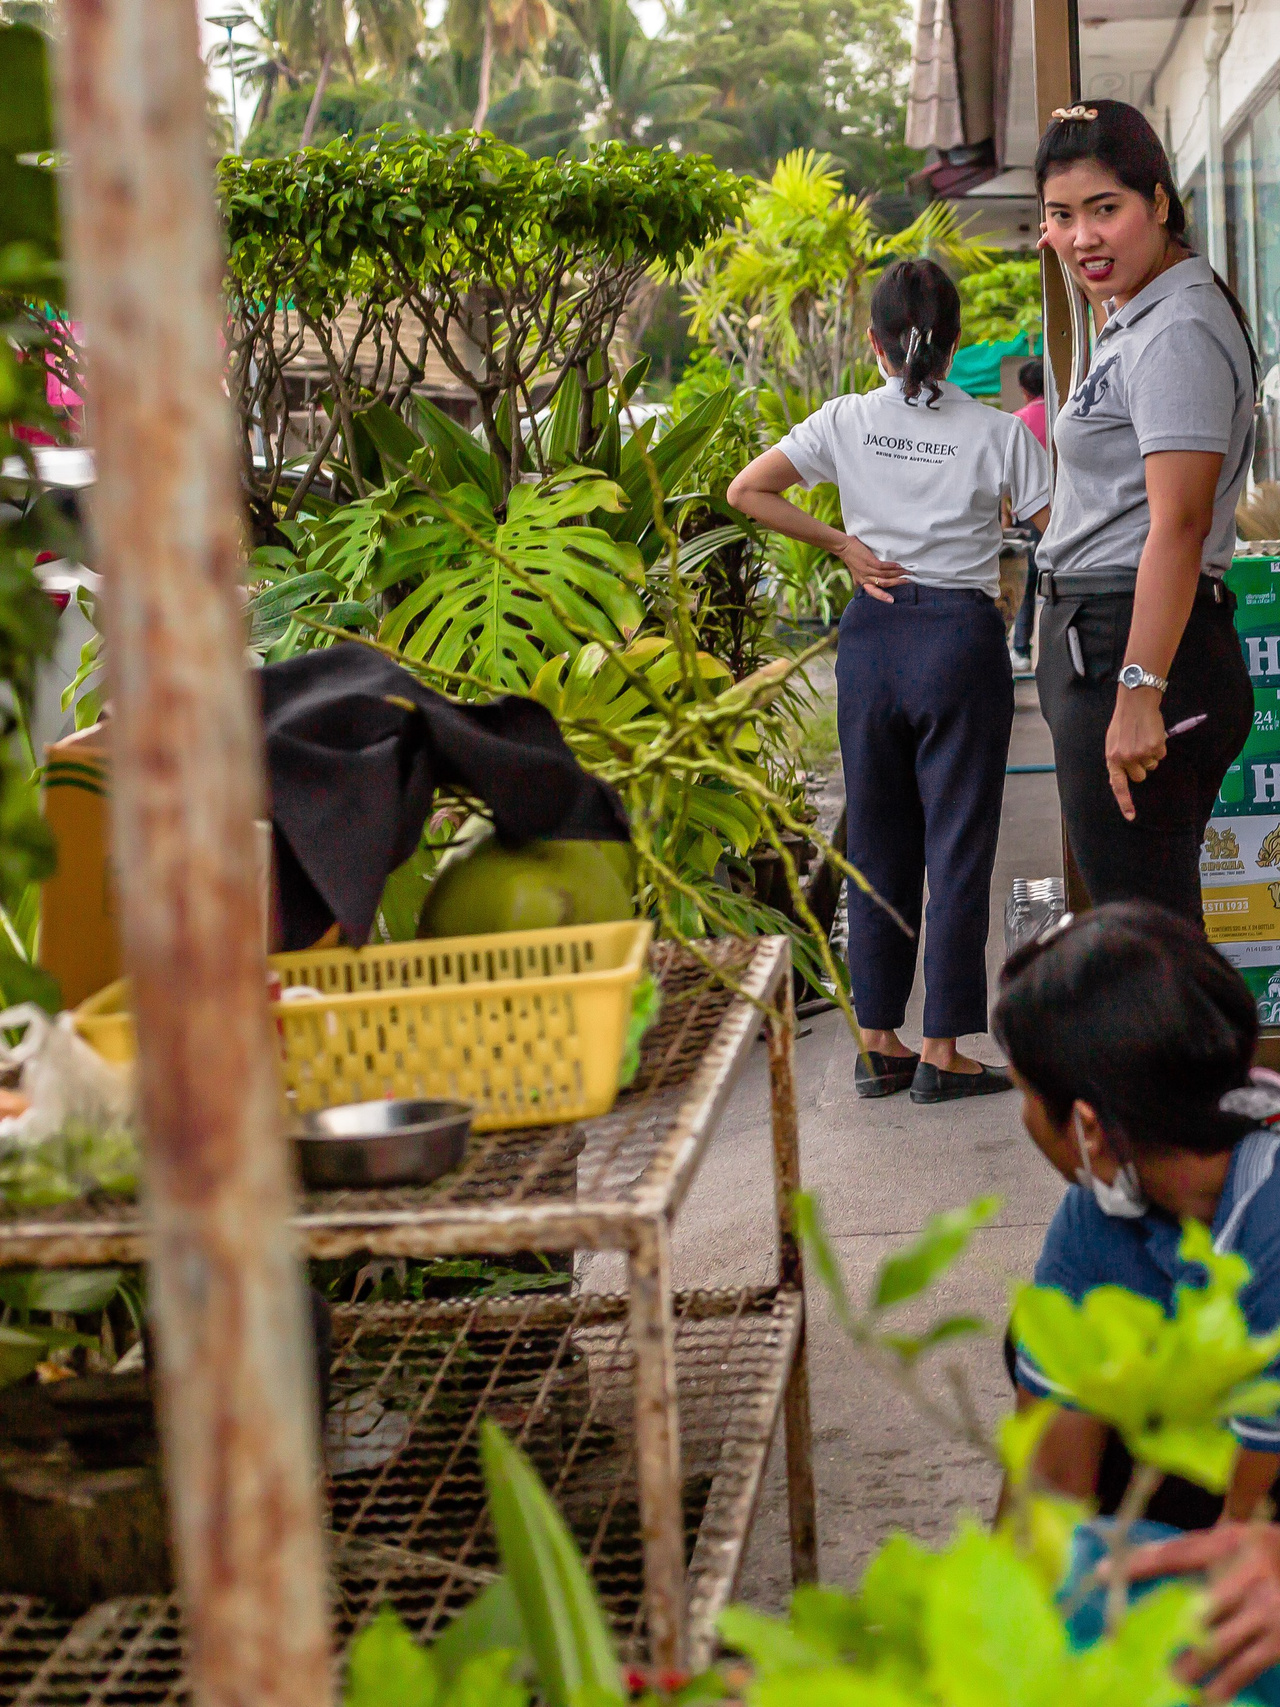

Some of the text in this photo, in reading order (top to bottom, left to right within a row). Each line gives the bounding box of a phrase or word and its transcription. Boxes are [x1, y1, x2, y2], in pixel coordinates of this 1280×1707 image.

[863, 434, 957, 456] JACOB'S CREEK
[1254, 711, 1273, 725] 24
[1226, 901, 1249, 911] 1933
